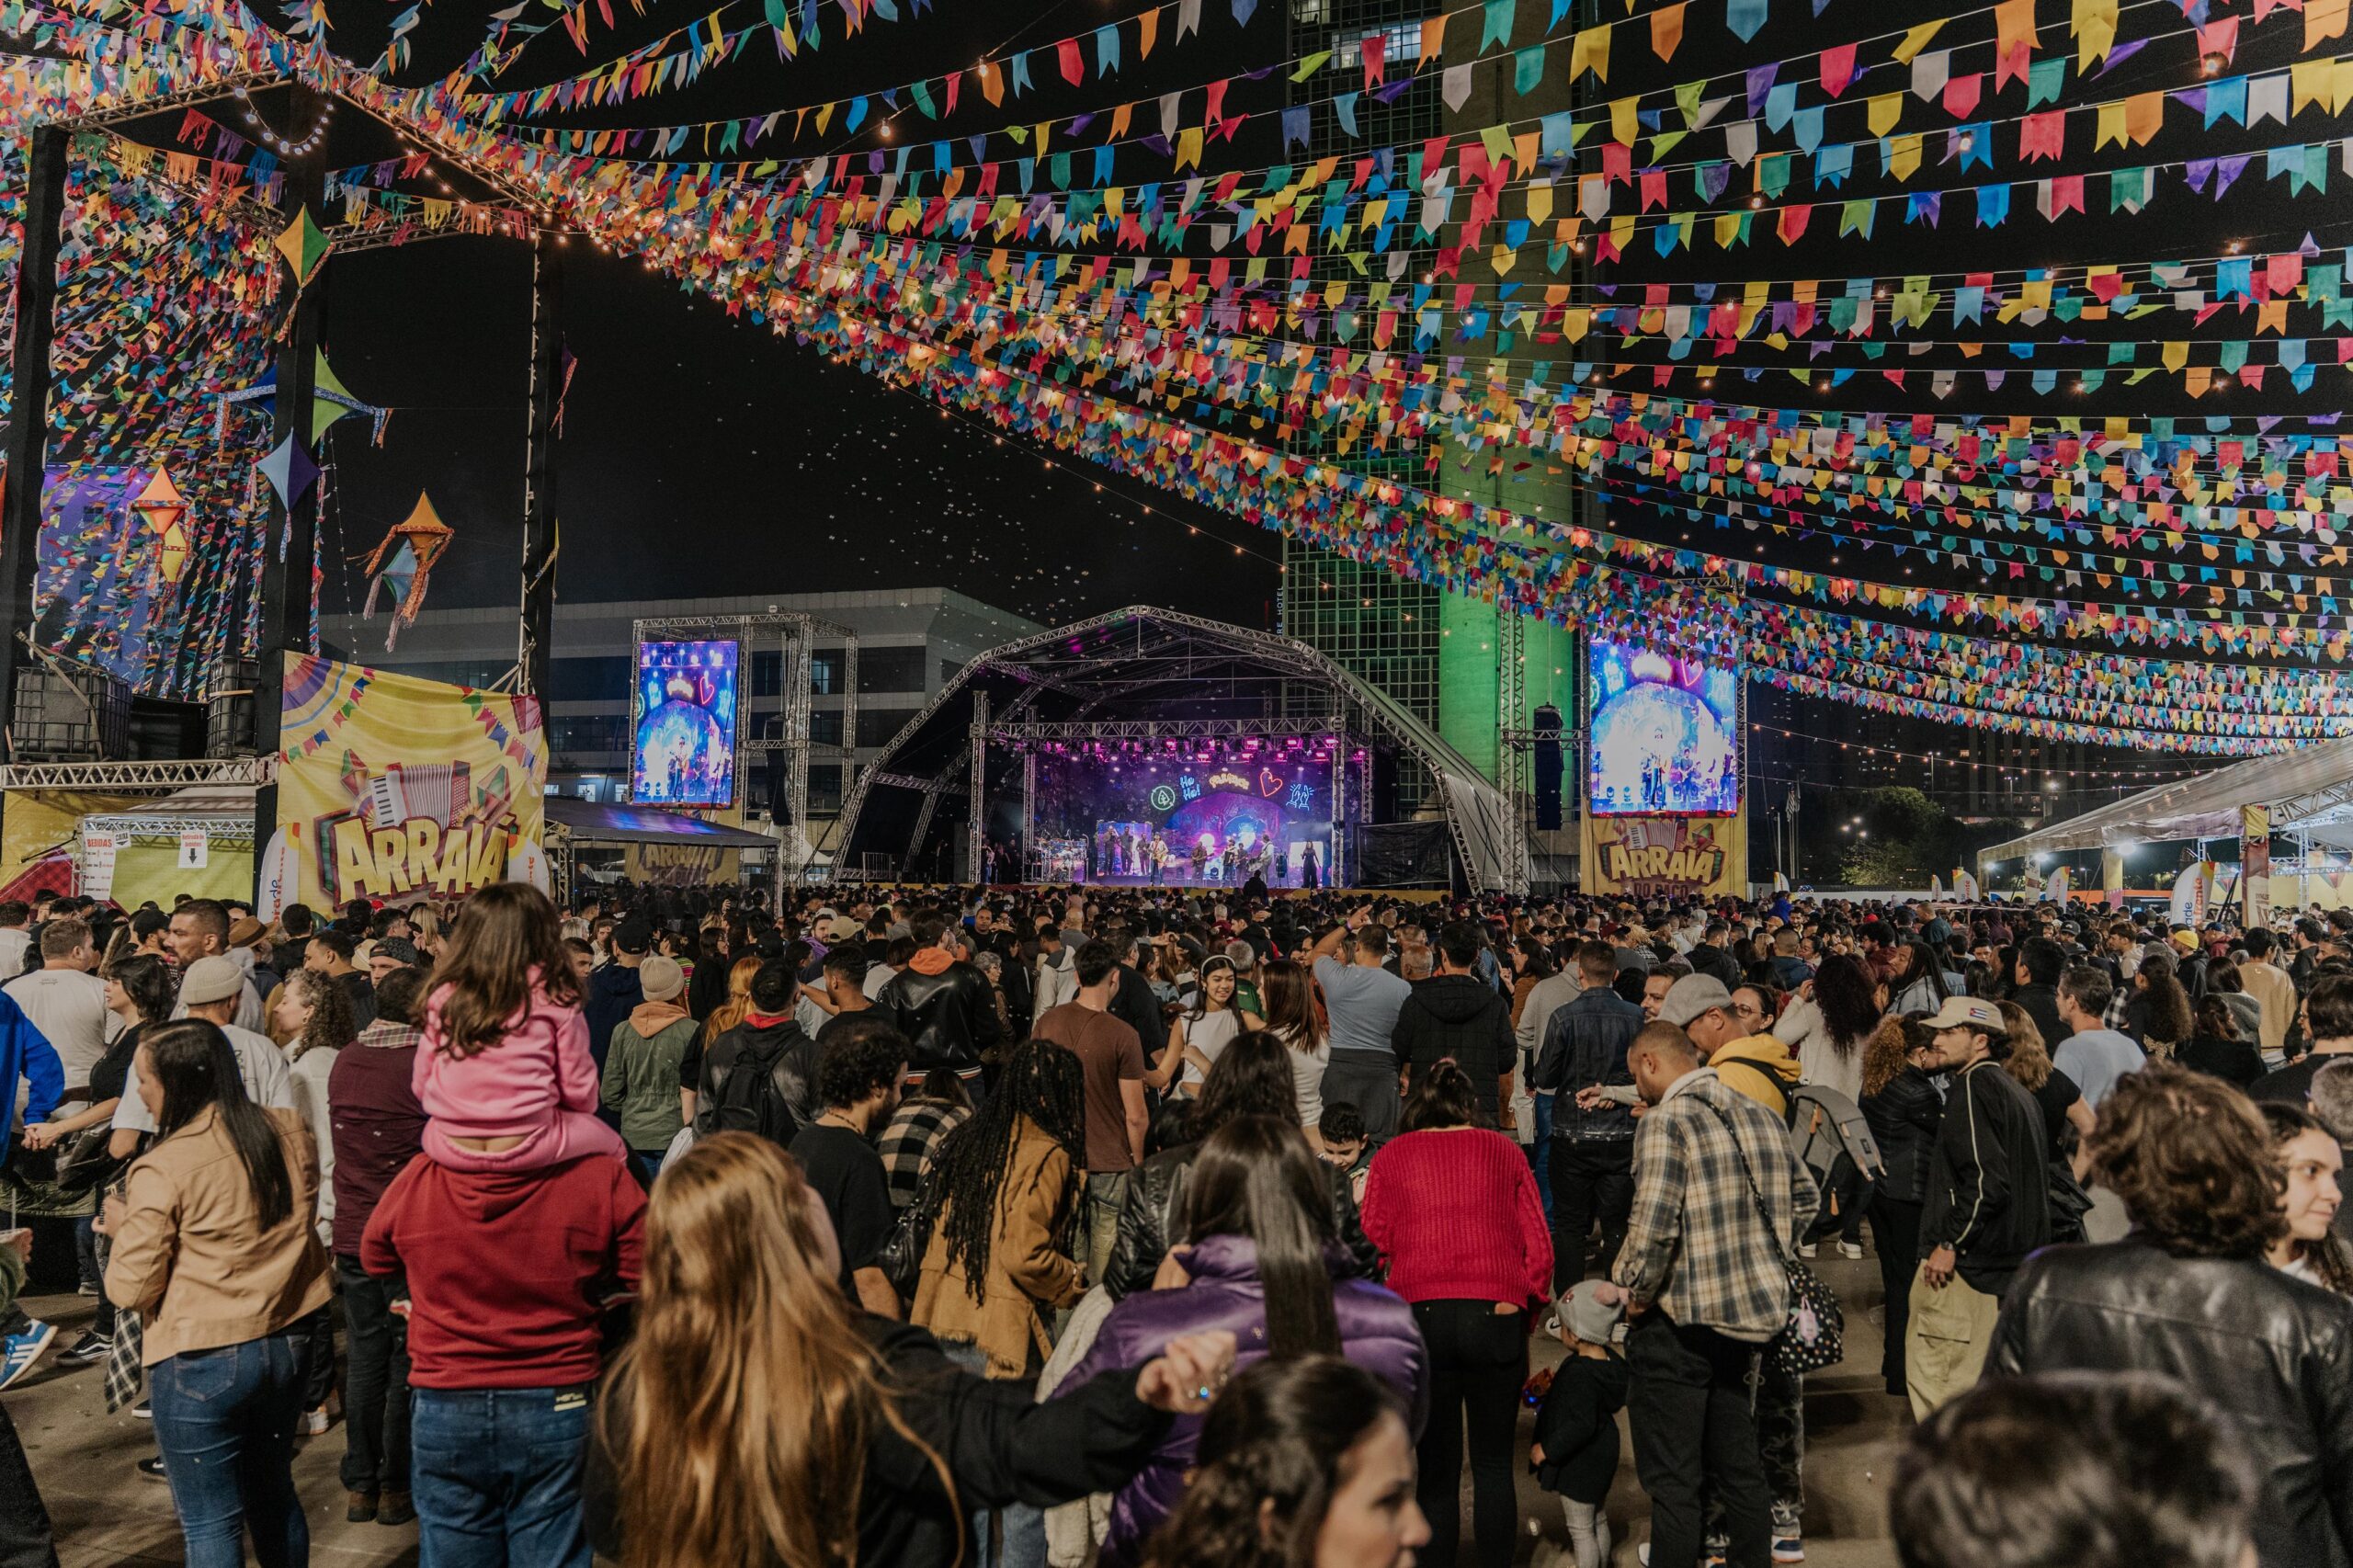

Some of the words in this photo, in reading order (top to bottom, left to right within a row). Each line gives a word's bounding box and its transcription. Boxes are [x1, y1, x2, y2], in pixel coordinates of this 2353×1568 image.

[86, 837, 112, 847] BEBIDAS
[115, 832, 129, 841] CAIXA
[334, 813, 515, 905] ARRAIÁ
[1609, 844, 1720, 883] ARRAIÁ
[1634, 882, 1651, 898] DO
[2182, 902, 2193, 926] ade
